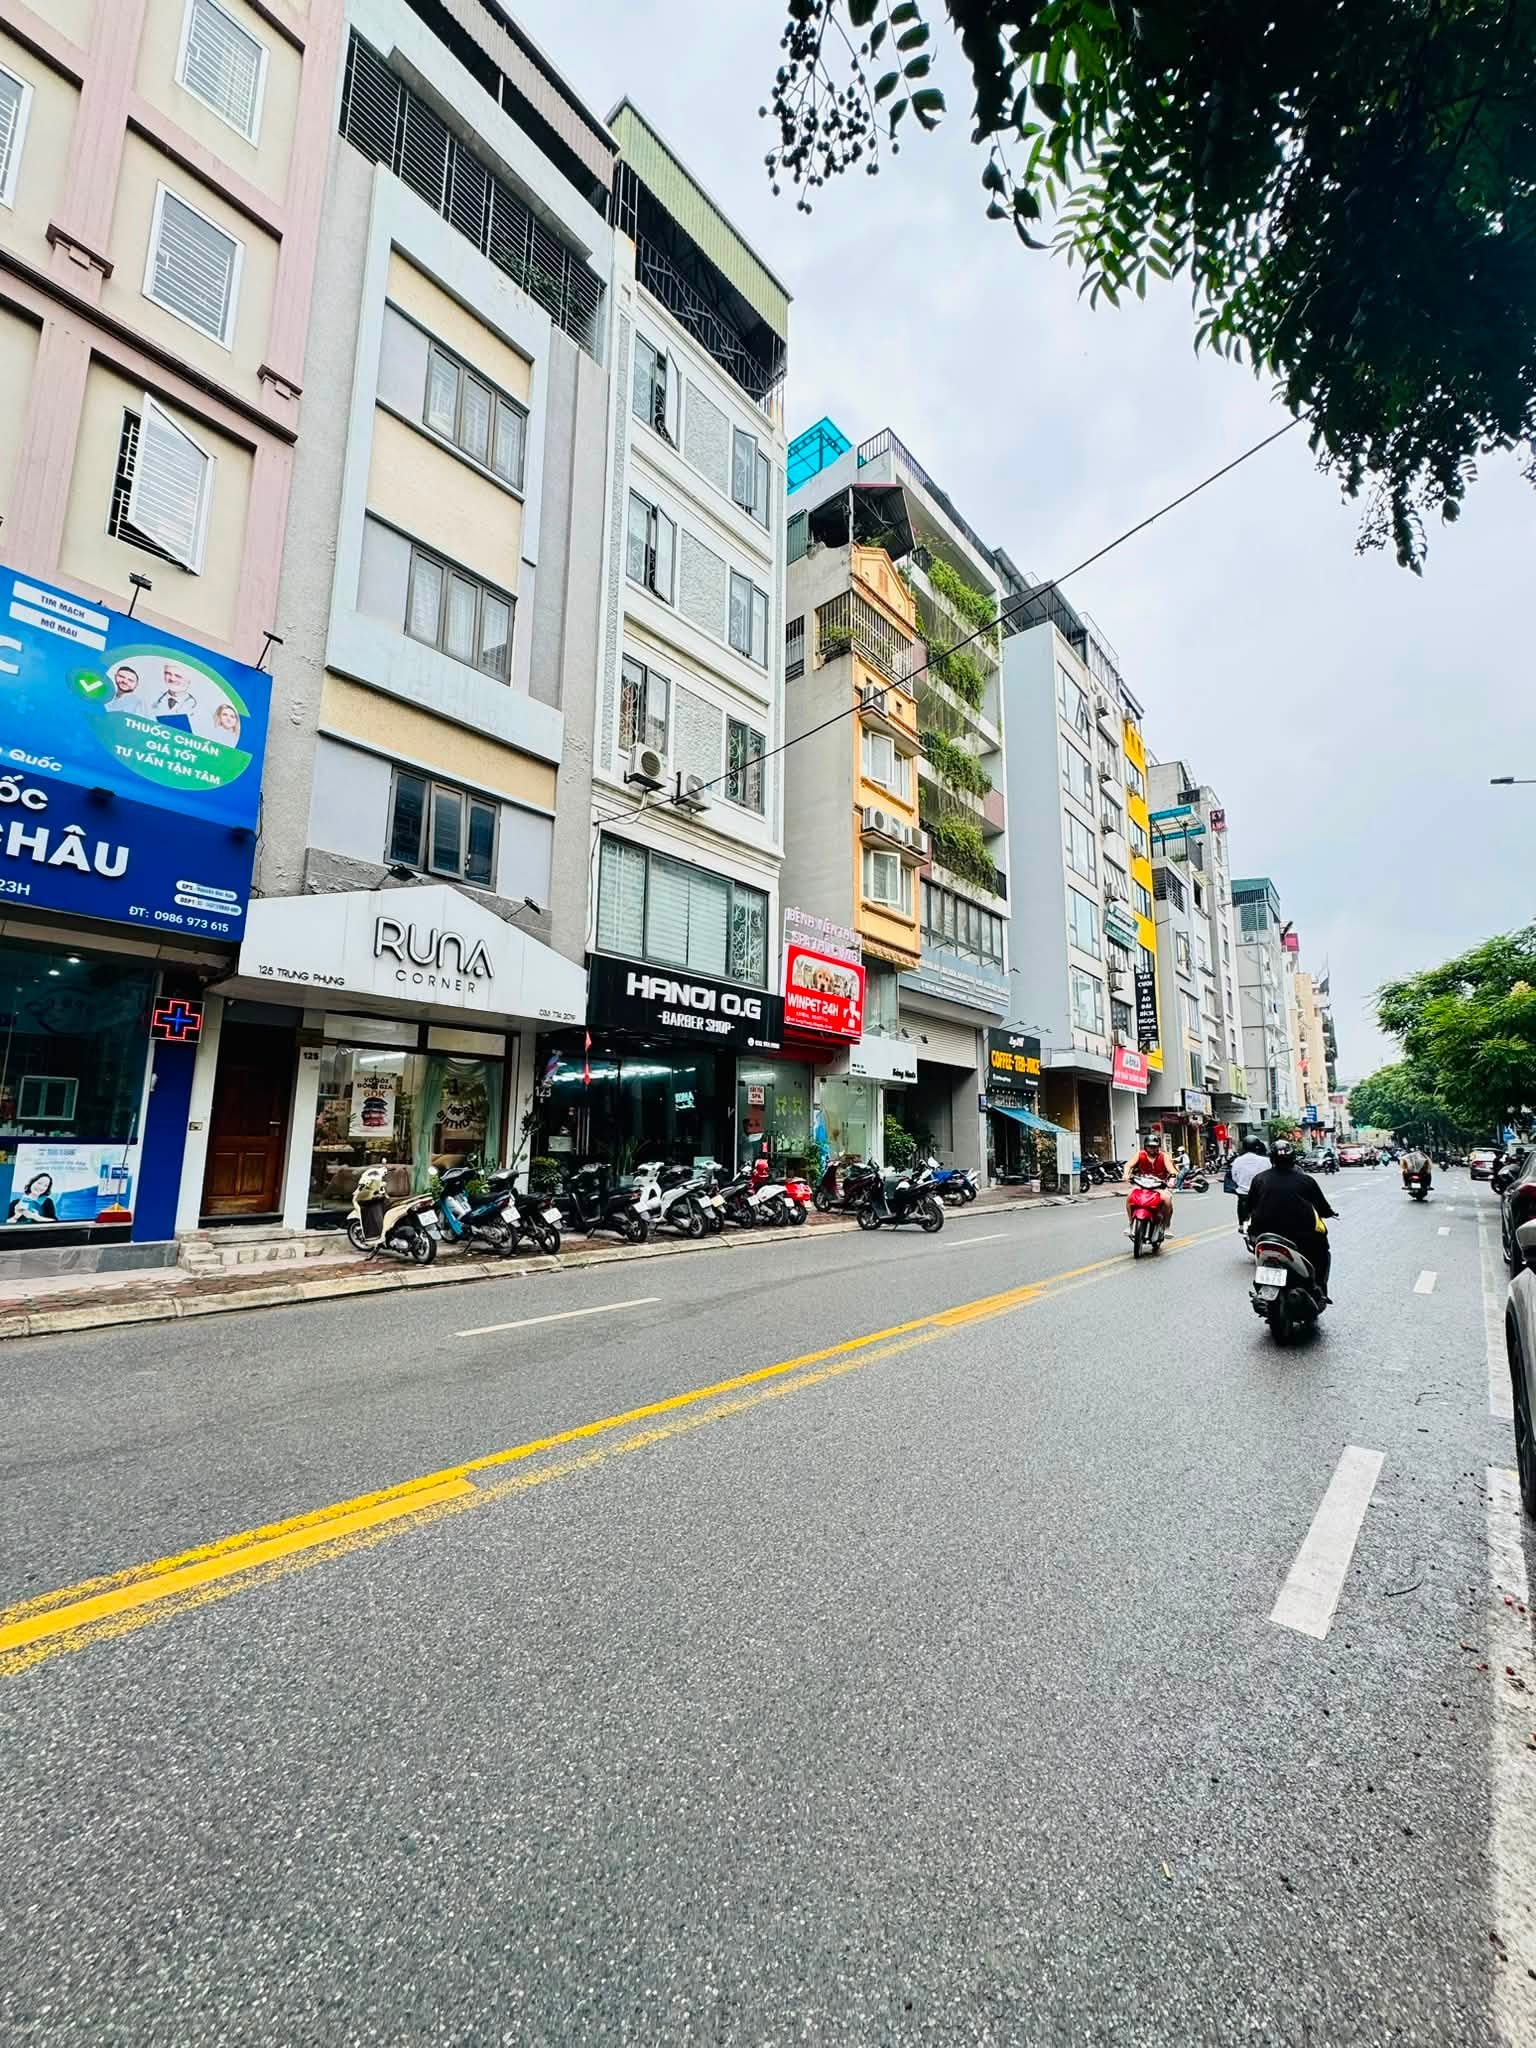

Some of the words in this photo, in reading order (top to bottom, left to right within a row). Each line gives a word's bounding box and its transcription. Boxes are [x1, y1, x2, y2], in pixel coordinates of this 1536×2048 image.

[9, 748, 63, 772] Quốc
[0, 820, 129, 877] HÂU
[154, 911, 183, 924] 0986
[187, 917, 208, 929] 973
[210, 921, 229, 932] 615
[277, 967, 309, 981] TRUNG
[395, 969, 476, 993] CORNER
[626, 972, 717, 1011] HANOI
[720, 993, 762, 1020] O.G
[787, 992, 821, 1013] WINPET
[821, 1000, 839, 1016] 24H
[535, 1087, 551, 1097] 123
